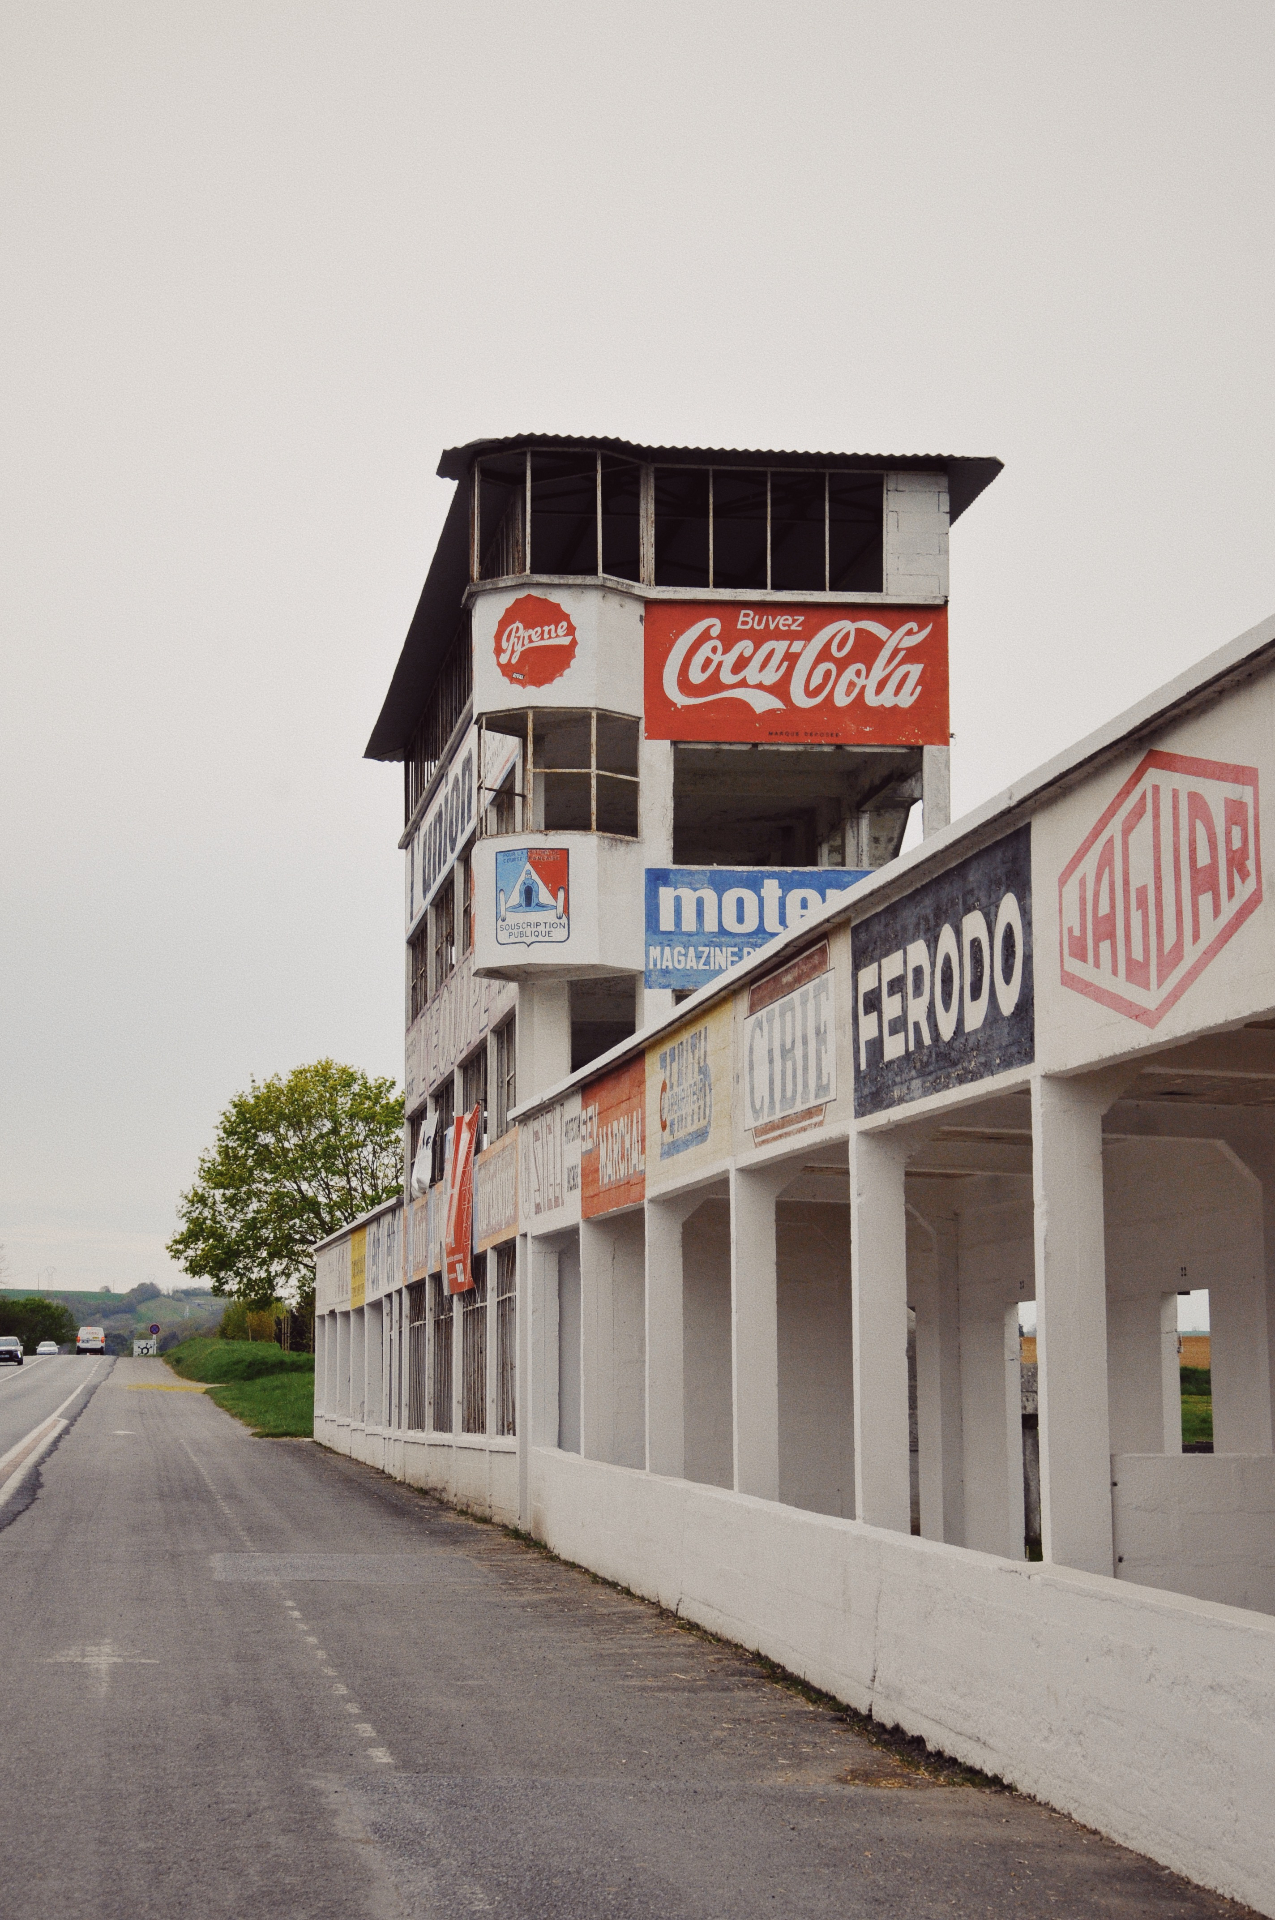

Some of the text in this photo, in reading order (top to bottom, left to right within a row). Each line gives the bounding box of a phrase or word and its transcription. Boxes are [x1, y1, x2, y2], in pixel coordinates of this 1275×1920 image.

[499, 620, 573, 664] Pyrene
[736, 609, 805, 631] Buvez
[662, 617, 933, 714] Coca-Cola
[659, 879, 842, 934] mote
[1067, 783, 1251, 992] JAGUAR
[500, 921, 566, 932] SOUSCRIPTION
[508, 930, 553, 939] PUBLIQUE
[649, 945, 739, 970] MAGAZINE
[857, 892, 1024, 1071] FERODO
[600, 1108, 646, 1186] MARCHAL
